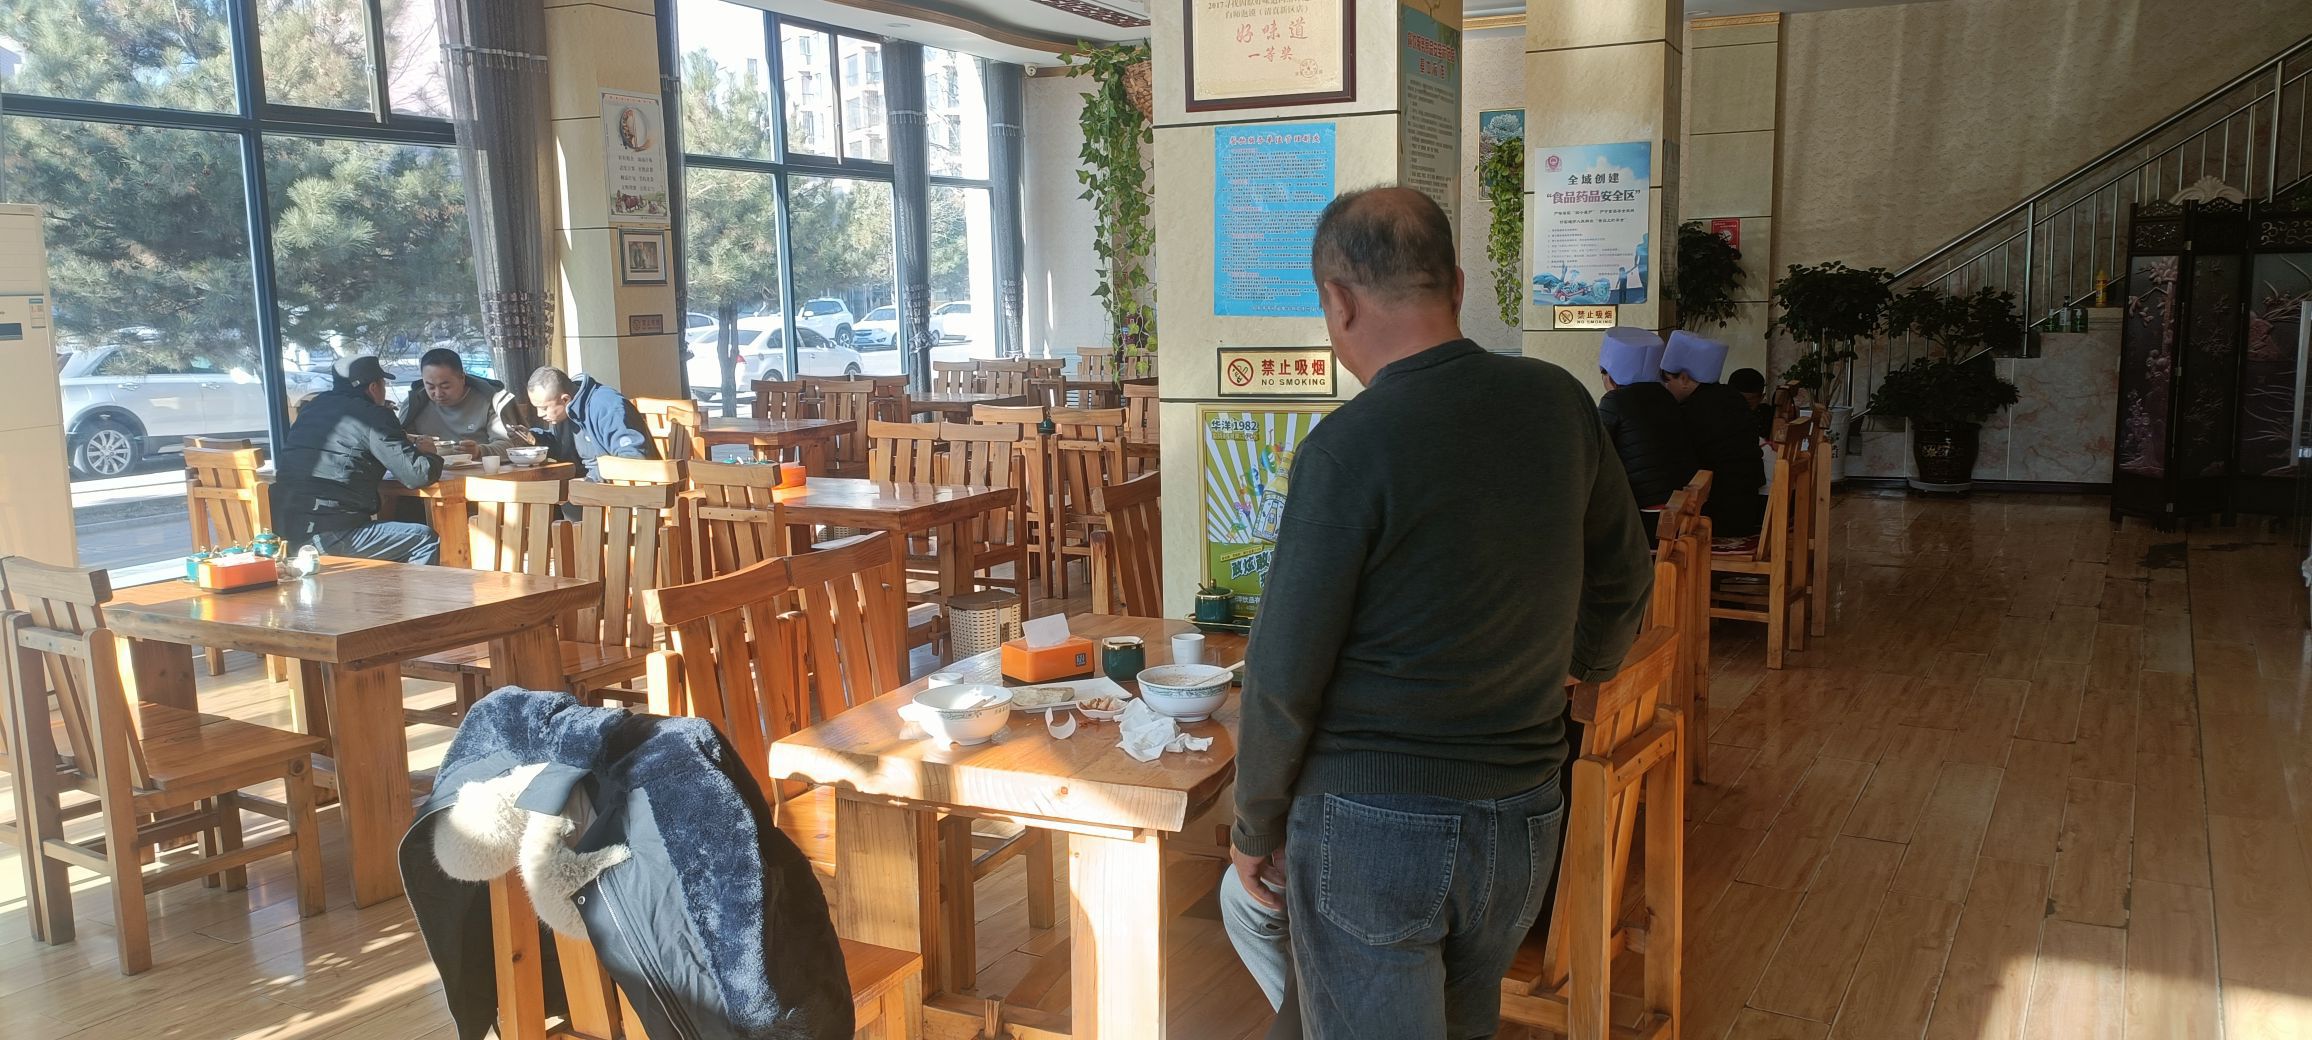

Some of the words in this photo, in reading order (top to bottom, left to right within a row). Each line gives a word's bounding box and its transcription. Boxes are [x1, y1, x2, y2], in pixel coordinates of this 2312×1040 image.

[1236, 16, 1309, 44] 好味道
[1248, 46, 1293, 62] 一等奖
[1568, 173, 1620, 186] 全域创建
[1577, 310, 1613, 319] 禁止吸烟
[1261, 359, 1326, 376] 禁止吸烟
